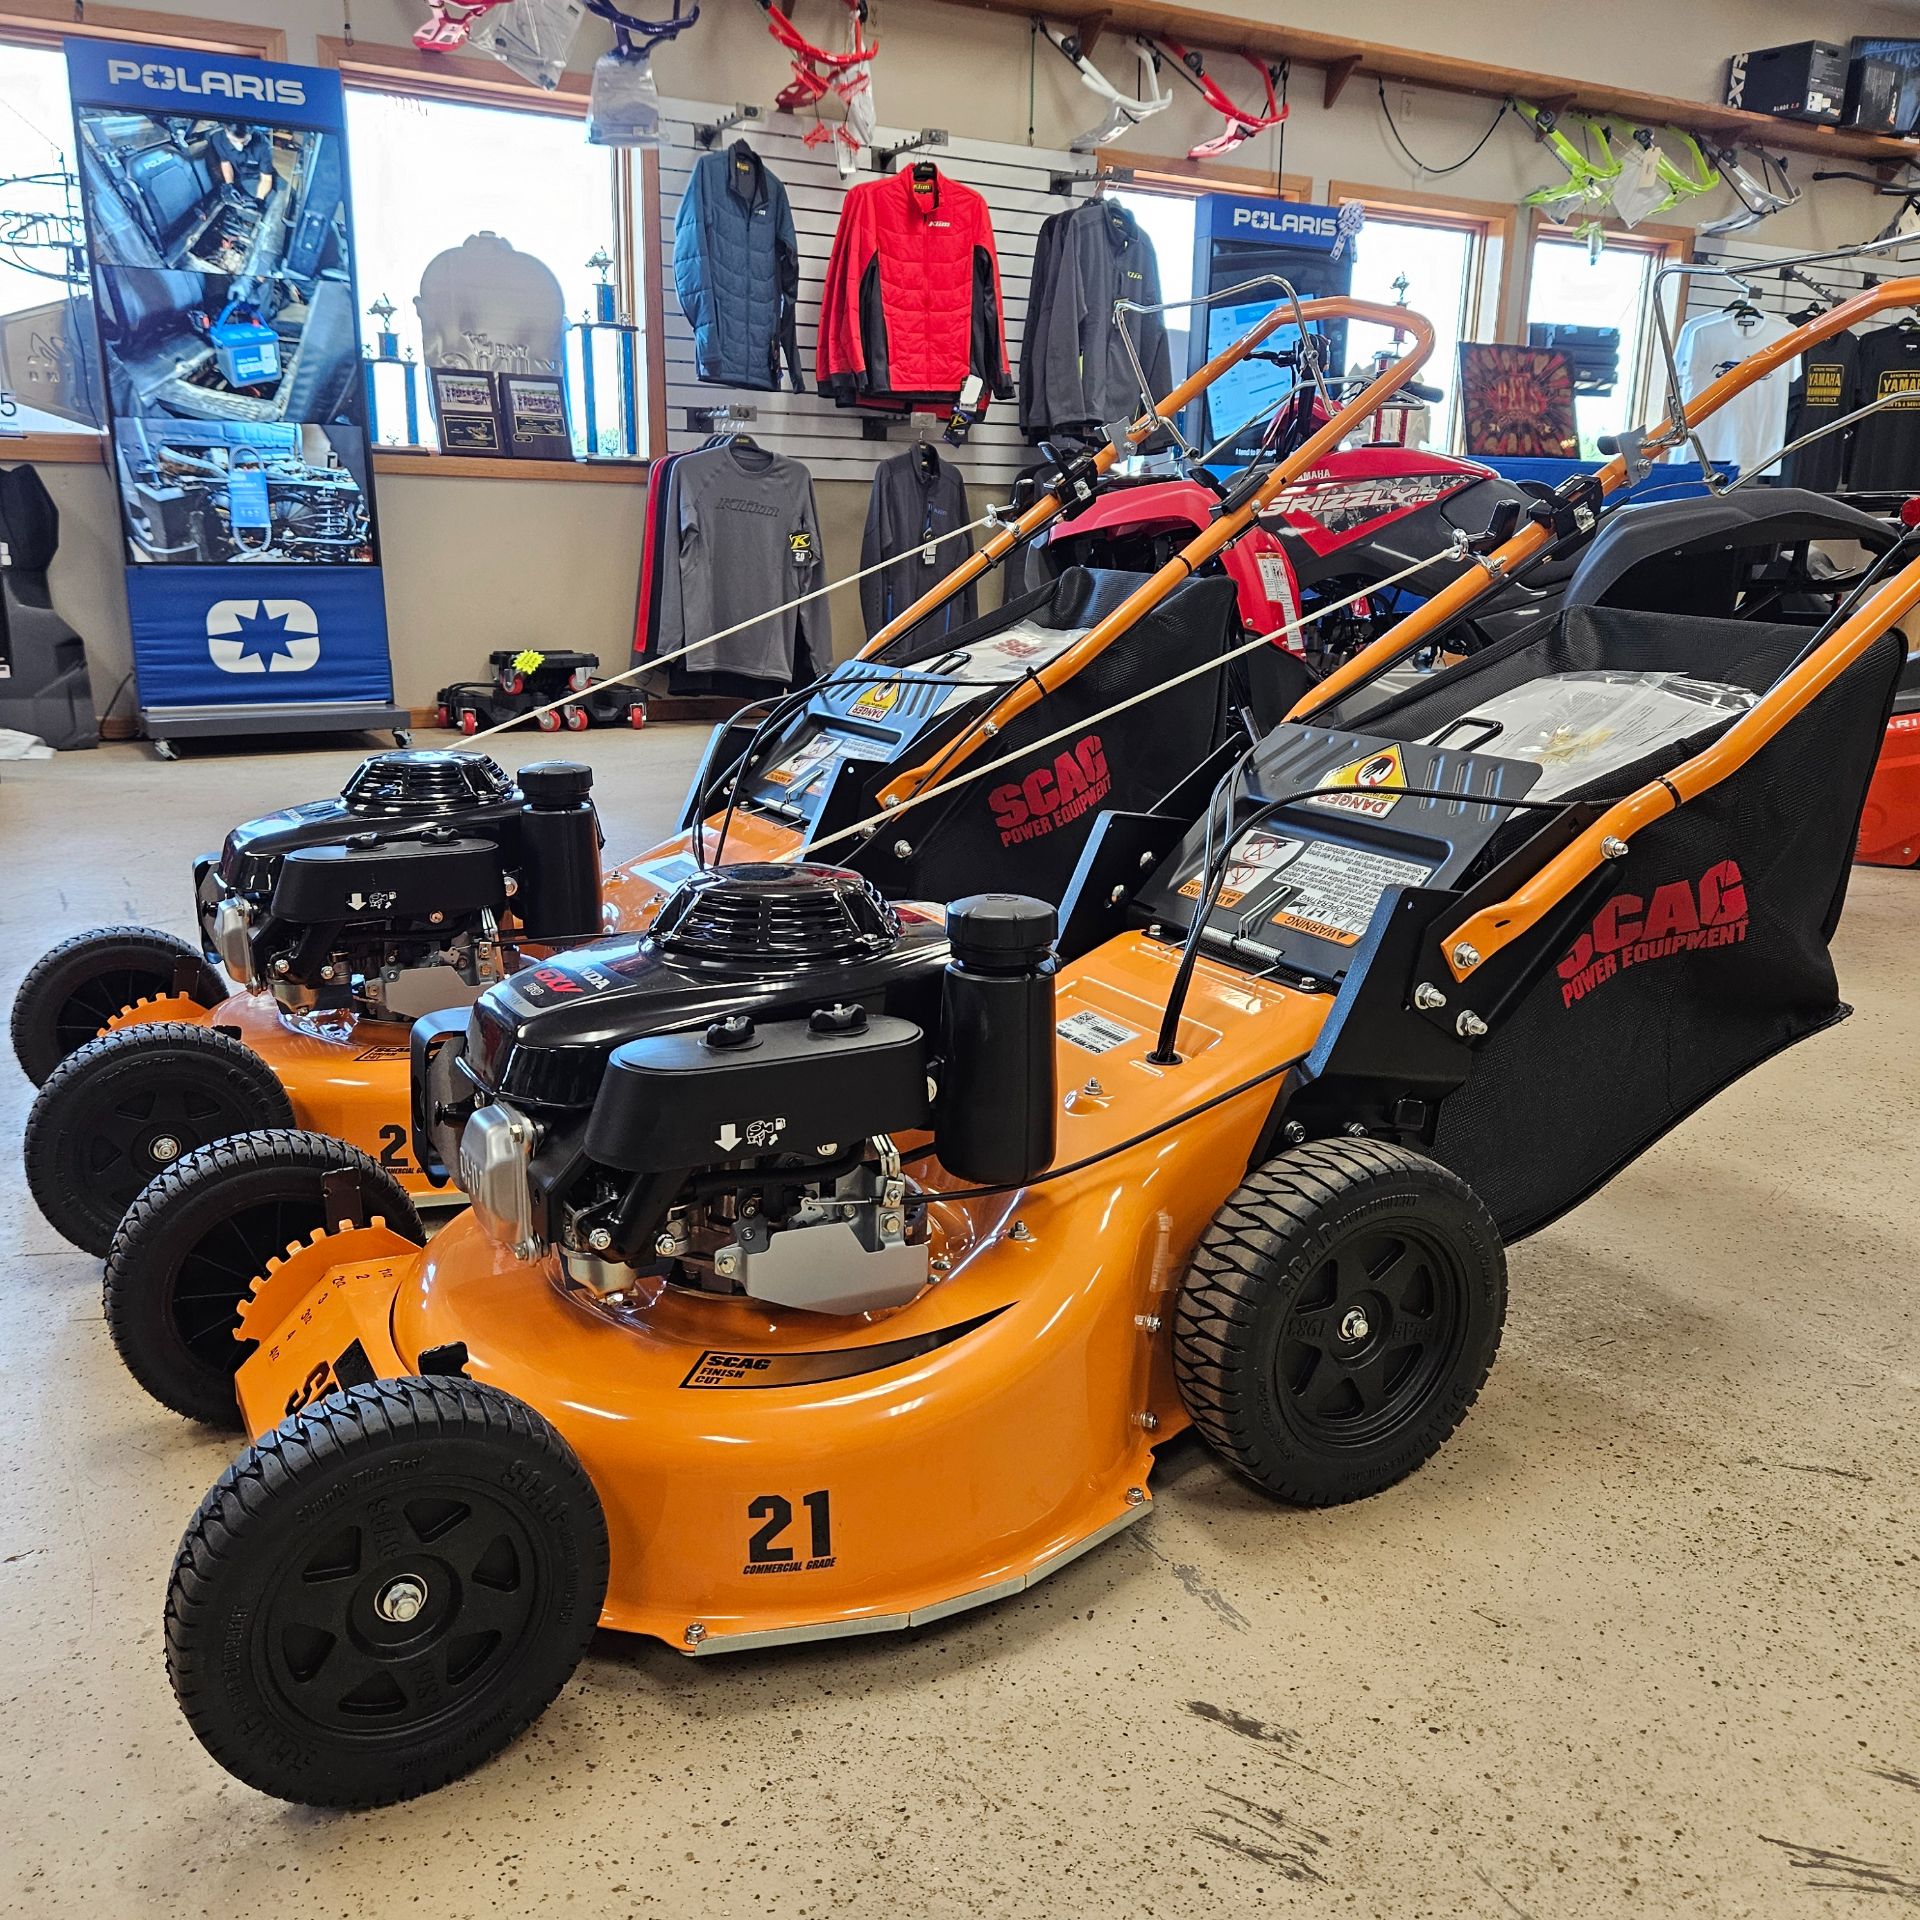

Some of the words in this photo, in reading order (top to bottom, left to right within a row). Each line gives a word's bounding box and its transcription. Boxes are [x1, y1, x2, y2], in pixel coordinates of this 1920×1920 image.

[108, 60, 306, 105] POLARIS
[1728, 53, 1748, 108] XR
[1233, 207, 1337, 237] POLARIS
[1808, 373, 1841, 386] YAMAHA
[1298, 469, 1331, 481] AMAHA
[1258, 486, 1423, 518] GRIZZLY
[852, 705, 884, 719] DANGER
[988, 735, 1107, 829] SCAG
[1000, 816, 1053, 848] POWER
[1052, 773, 1111, 828] EQUIPMENT
[1317, 793, 1387, 814] DANGER
[1297, 894, 1345, 912] OPERATING
[1342, 907, 1373, 919] EFORE
[1284, 915, 1336, 938] WARNING
[1562, 954, 1618, 1009] POWER
[1621, 917, 1750, 968] EQUIPMENT
[523, 982, 545, 996] 160
[533, 968, 585, 993] GXV
[699, 1367, 746, 1379] FINISH
[706, 1355, 772, 1370] SCAG
[694, 1375, 724, 1386] CUT
[748, 1490, 832, 1562] 21
[742, 1561, 803, 1574] COMMERCIAL
[806, 1557, 838, 1571] GRADE
